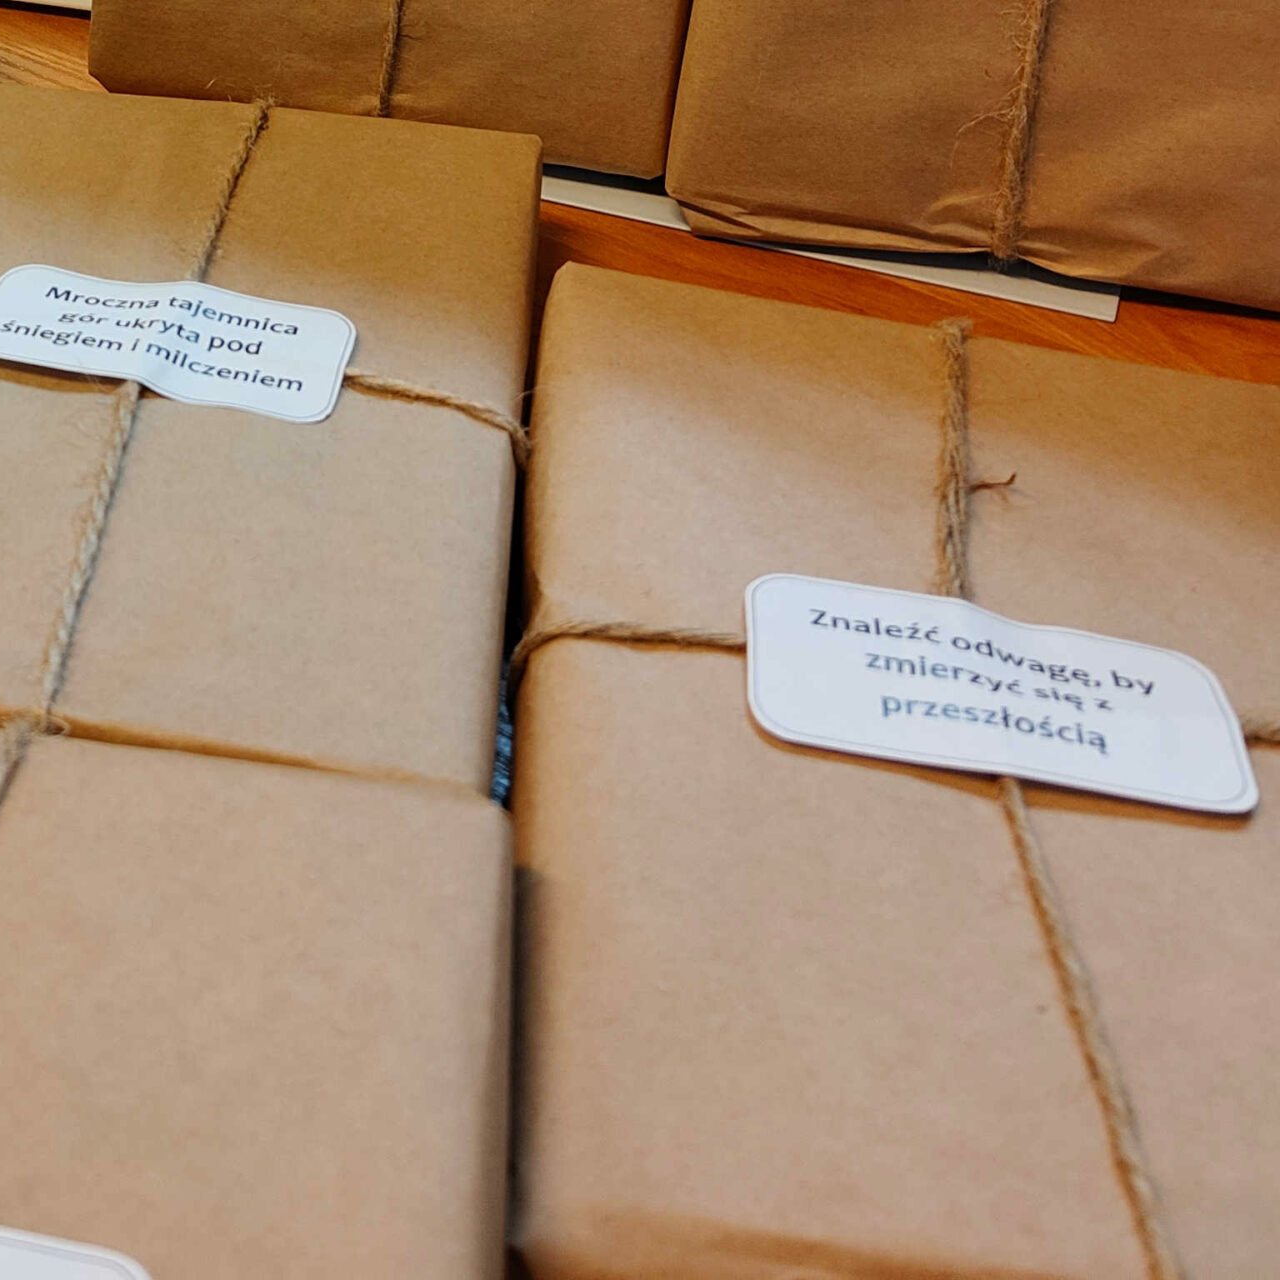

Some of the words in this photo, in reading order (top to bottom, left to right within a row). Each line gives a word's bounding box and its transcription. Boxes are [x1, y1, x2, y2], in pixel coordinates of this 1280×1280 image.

[45, 286, 160, 309] Mroczna
[169, 295, 299, 336] tajemnica
[58, 311, 110, 323] gór
[115, 319, 200, 344] ukryta
[208, 335, 263, 355] pod
[0, 320, 122, 351] śniegiem
[131, 339, 140, 351] i
[146, 342, 304, 392] milczeniem
[809, 608, 941, 645] Znaleźć
[952, 640, 1102, 688] odwagę,
[1111, 670, 1155, 696] by
[865, 651, 1024, 695] zmierzyć
[1033, 686, 1085, 711] się
[1093, 698, 1114, 711] z
[881, 694, 1110, 754] przeszłością
